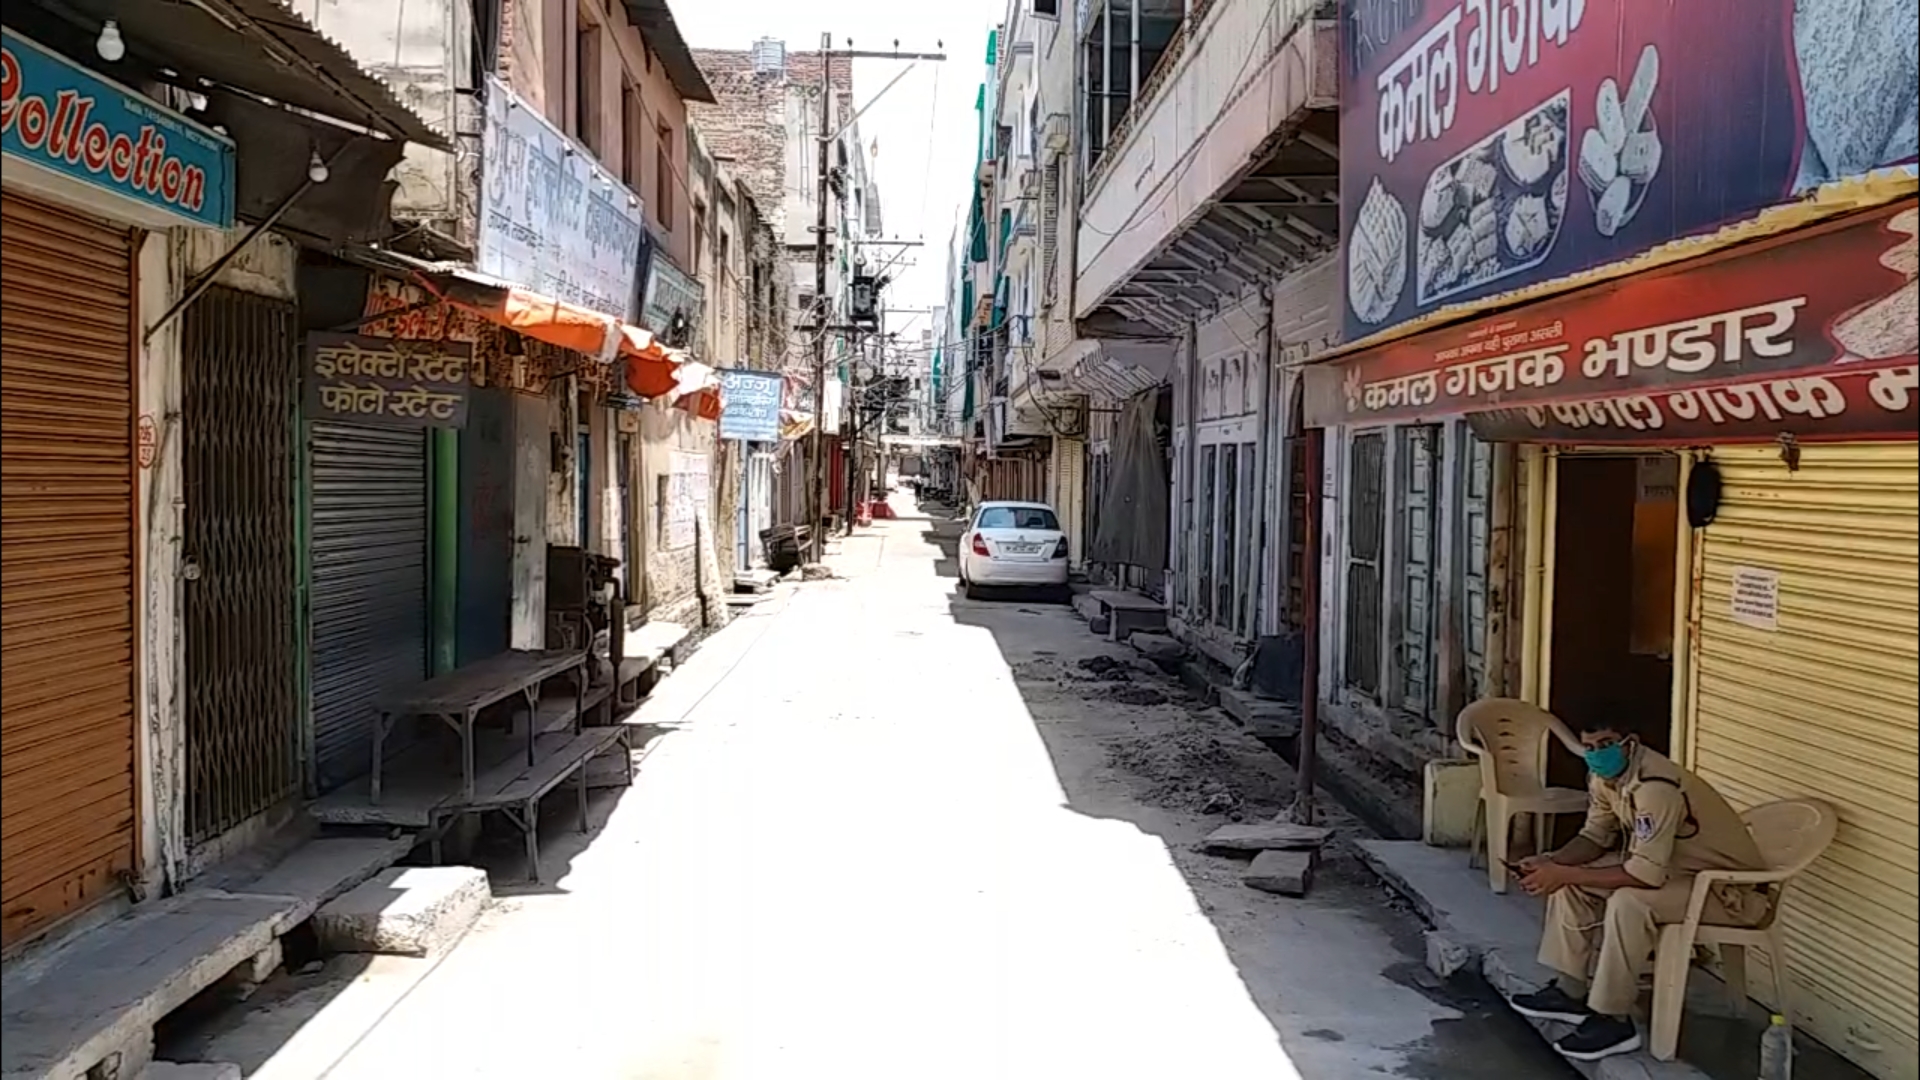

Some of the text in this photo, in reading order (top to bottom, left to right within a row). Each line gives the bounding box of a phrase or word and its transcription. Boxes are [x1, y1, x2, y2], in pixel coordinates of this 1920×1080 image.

[1378, 5, 1461, 163] कमल
[318, 381, 463, 419] फोटो स्टेट
[1364, 297, 1807, 411] कमल गजक भण्डार
